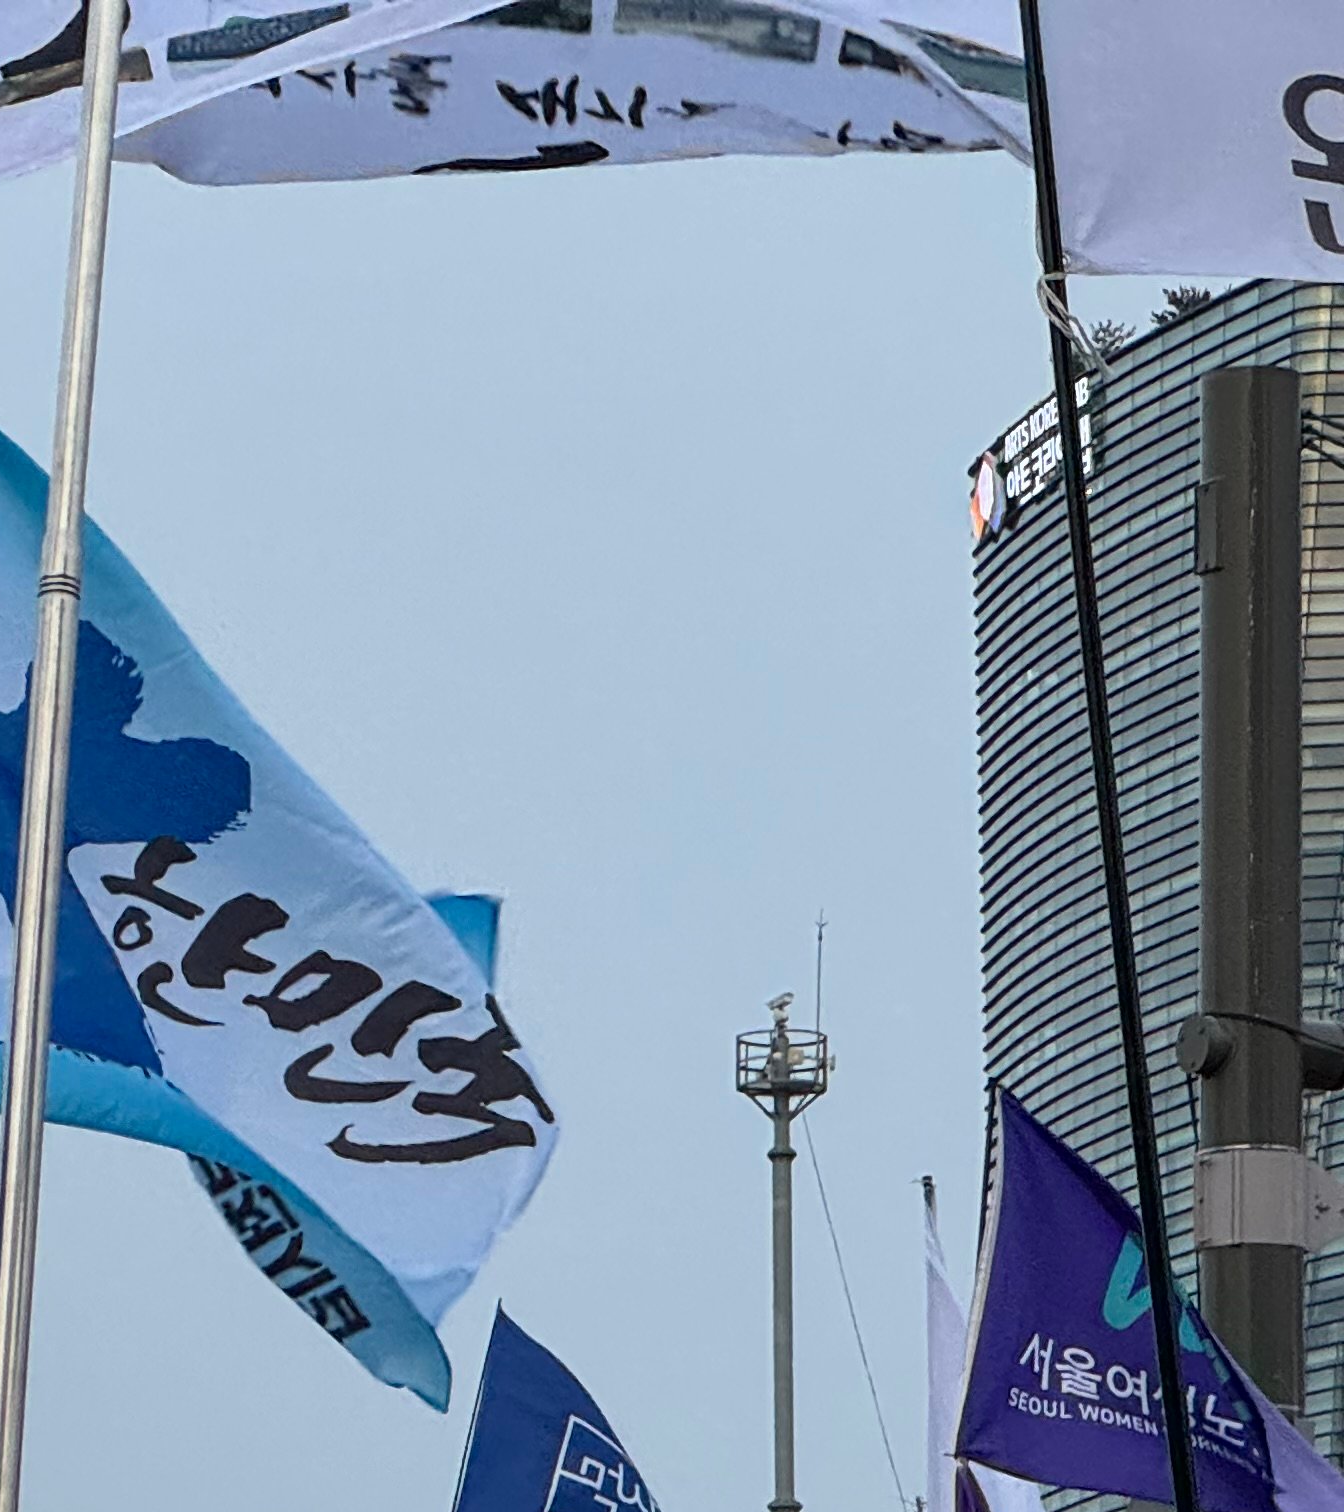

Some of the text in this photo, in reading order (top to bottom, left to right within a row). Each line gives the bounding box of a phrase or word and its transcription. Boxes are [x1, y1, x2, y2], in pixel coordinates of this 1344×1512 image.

[1004, 396, 1062, 464] ARTS KORE
[1008, 1386, 1159, 1437] SEOUL WOMEN
